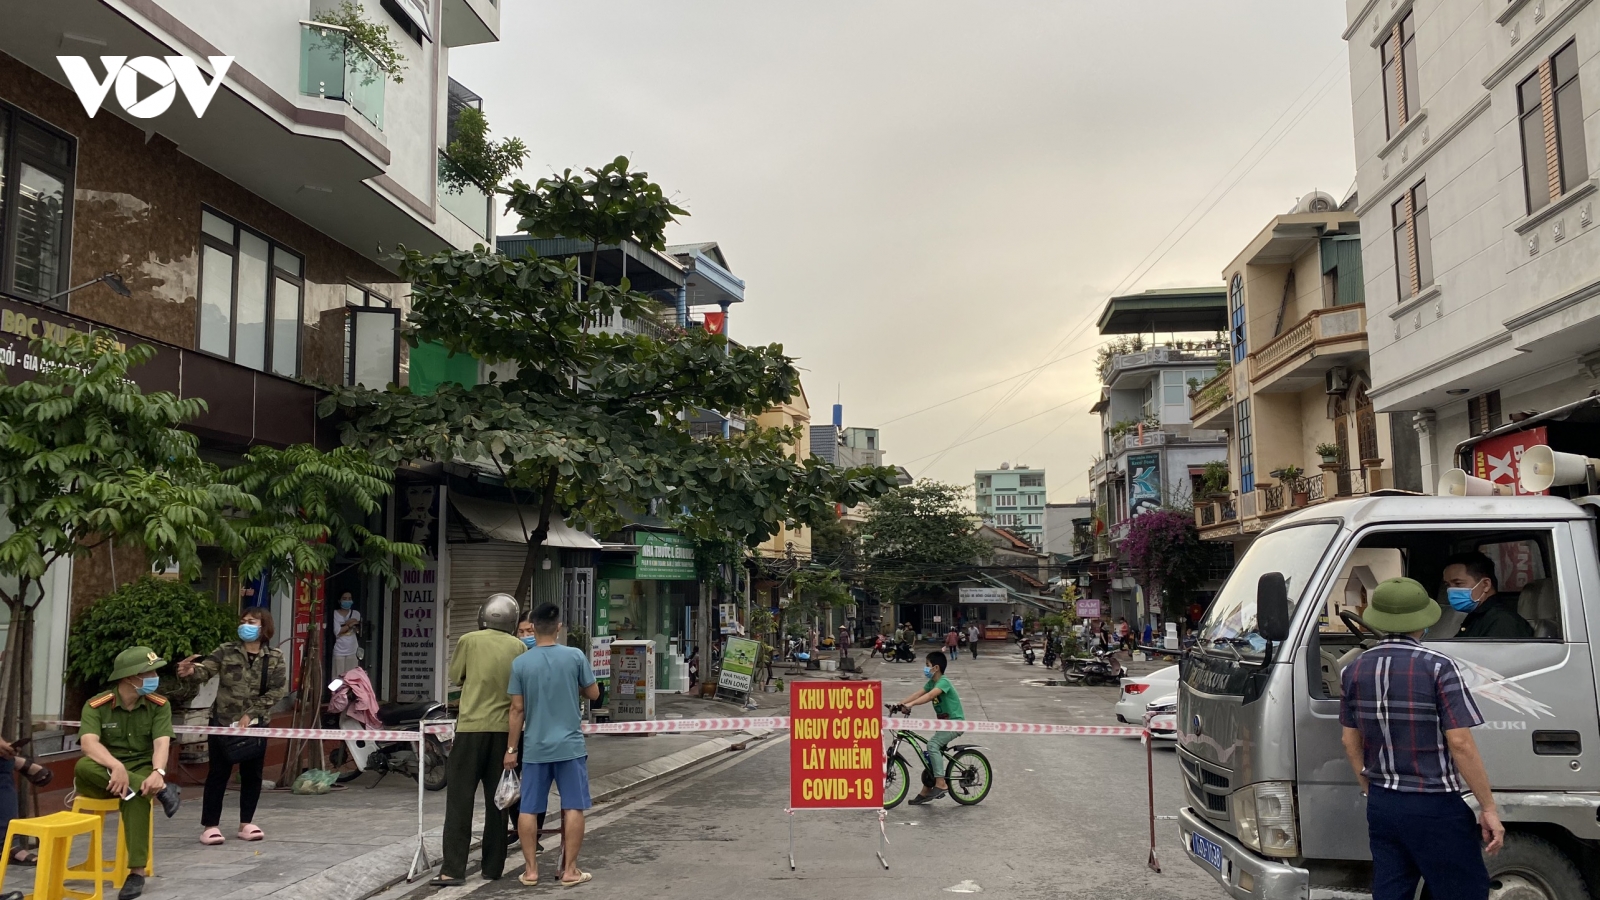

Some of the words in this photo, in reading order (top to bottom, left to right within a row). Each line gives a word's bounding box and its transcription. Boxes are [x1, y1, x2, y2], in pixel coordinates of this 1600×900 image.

[1, 308, 38, 340] BẠC
[23, 356, 38, 372] GIA
[423, 570, 435, 584] MI
[403, 590, 434, 602] NAIL
[404, 606, 431, 622] GỘI
[402, 624, 433, 638] ĐẦU
[733, 681, 748, 690] LONG
[799, 688, 824, 710] KHU
[828, 686, 853, 714] VỰC
[857, 684, 874, 709] CÓ
[794, 718, 829, 739] NGUY
[832, 717, 850, 739] CƠ
[853, 718, 879, 739] CAO
[802, 744, 826, 770] LÂY
[830, 740, 872, 770] NHIỄM
[802, 778, 874, 800] COVID-19
